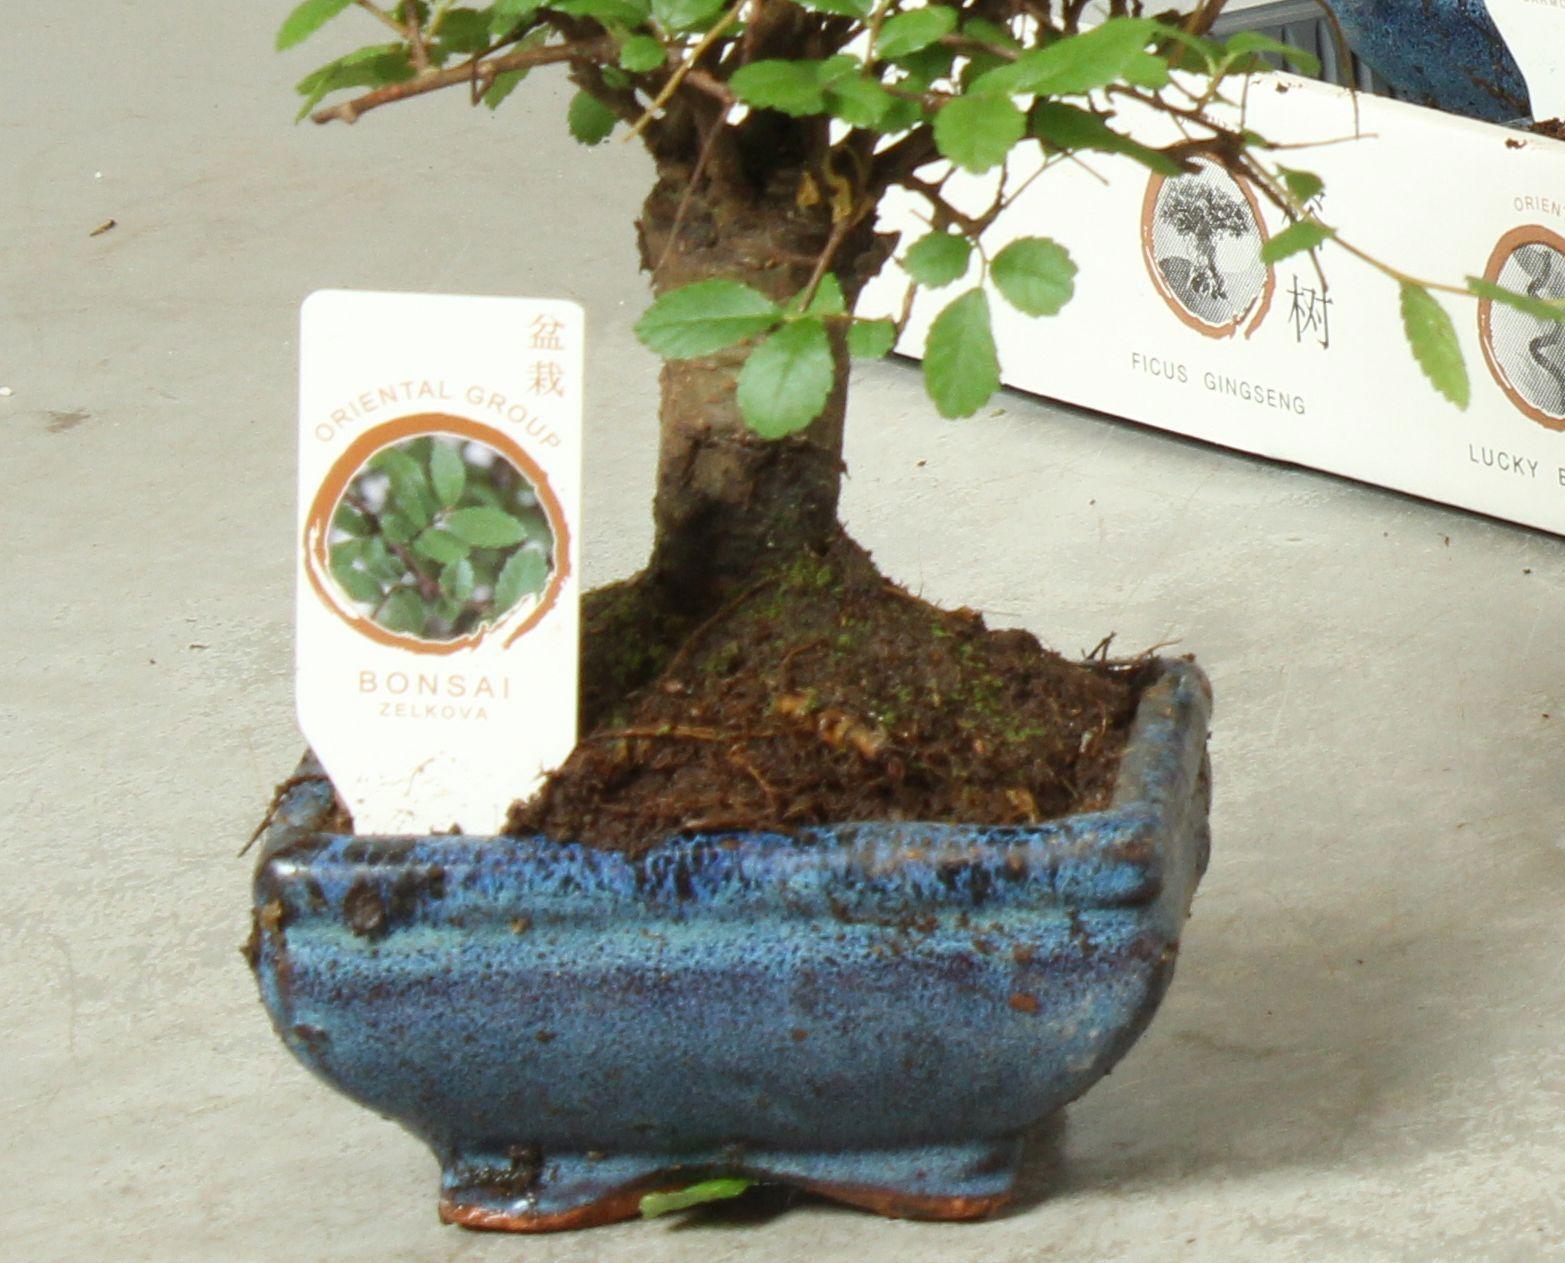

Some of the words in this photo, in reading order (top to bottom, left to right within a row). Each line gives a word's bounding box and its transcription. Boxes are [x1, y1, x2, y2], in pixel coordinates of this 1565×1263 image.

[527, 312, 567, 399] 盆栽
[1131, 351, 1189, 384] FICUS
[1203, 371, 1306, 415] GINGSENG
[314, 379, 454, 443] ORIENTAL
[465, 384, 563, 449] GROUP
[1468, 443, 1539, 479] LUCKY
[357, 669, 512, 700] BONSAI
[377, 701, 490, 721] ZELKOVA
